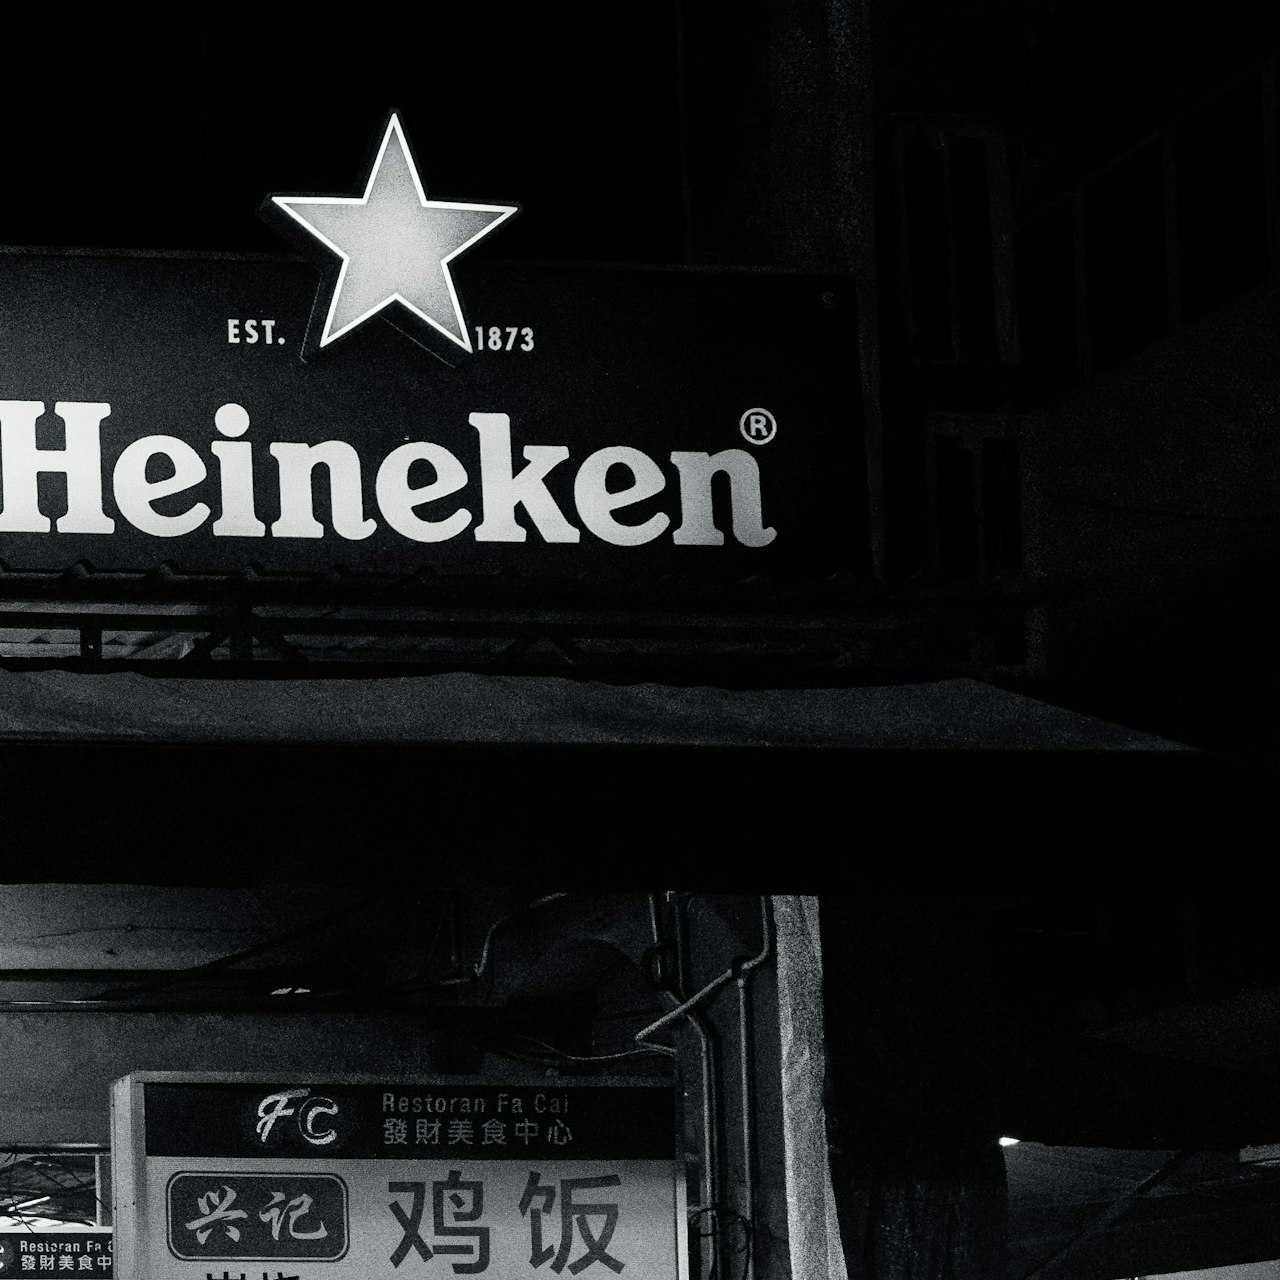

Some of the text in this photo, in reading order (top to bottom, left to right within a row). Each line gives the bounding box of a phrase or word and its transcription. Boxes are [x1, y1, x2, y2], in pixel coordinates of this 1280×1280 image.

[227, 319, 535, 353] EST. 1873
[382, 1093, 485, 1114] Restoran
[497, 1094, 523, 1114] Fa
[534, 1094, 569, 1114] Cai
[383, 1118, 573, 1146] 發財美食中心
[184, 1185, 327, 1246] 兴记
[387, 1170, 628, 1276] 鸡饭
